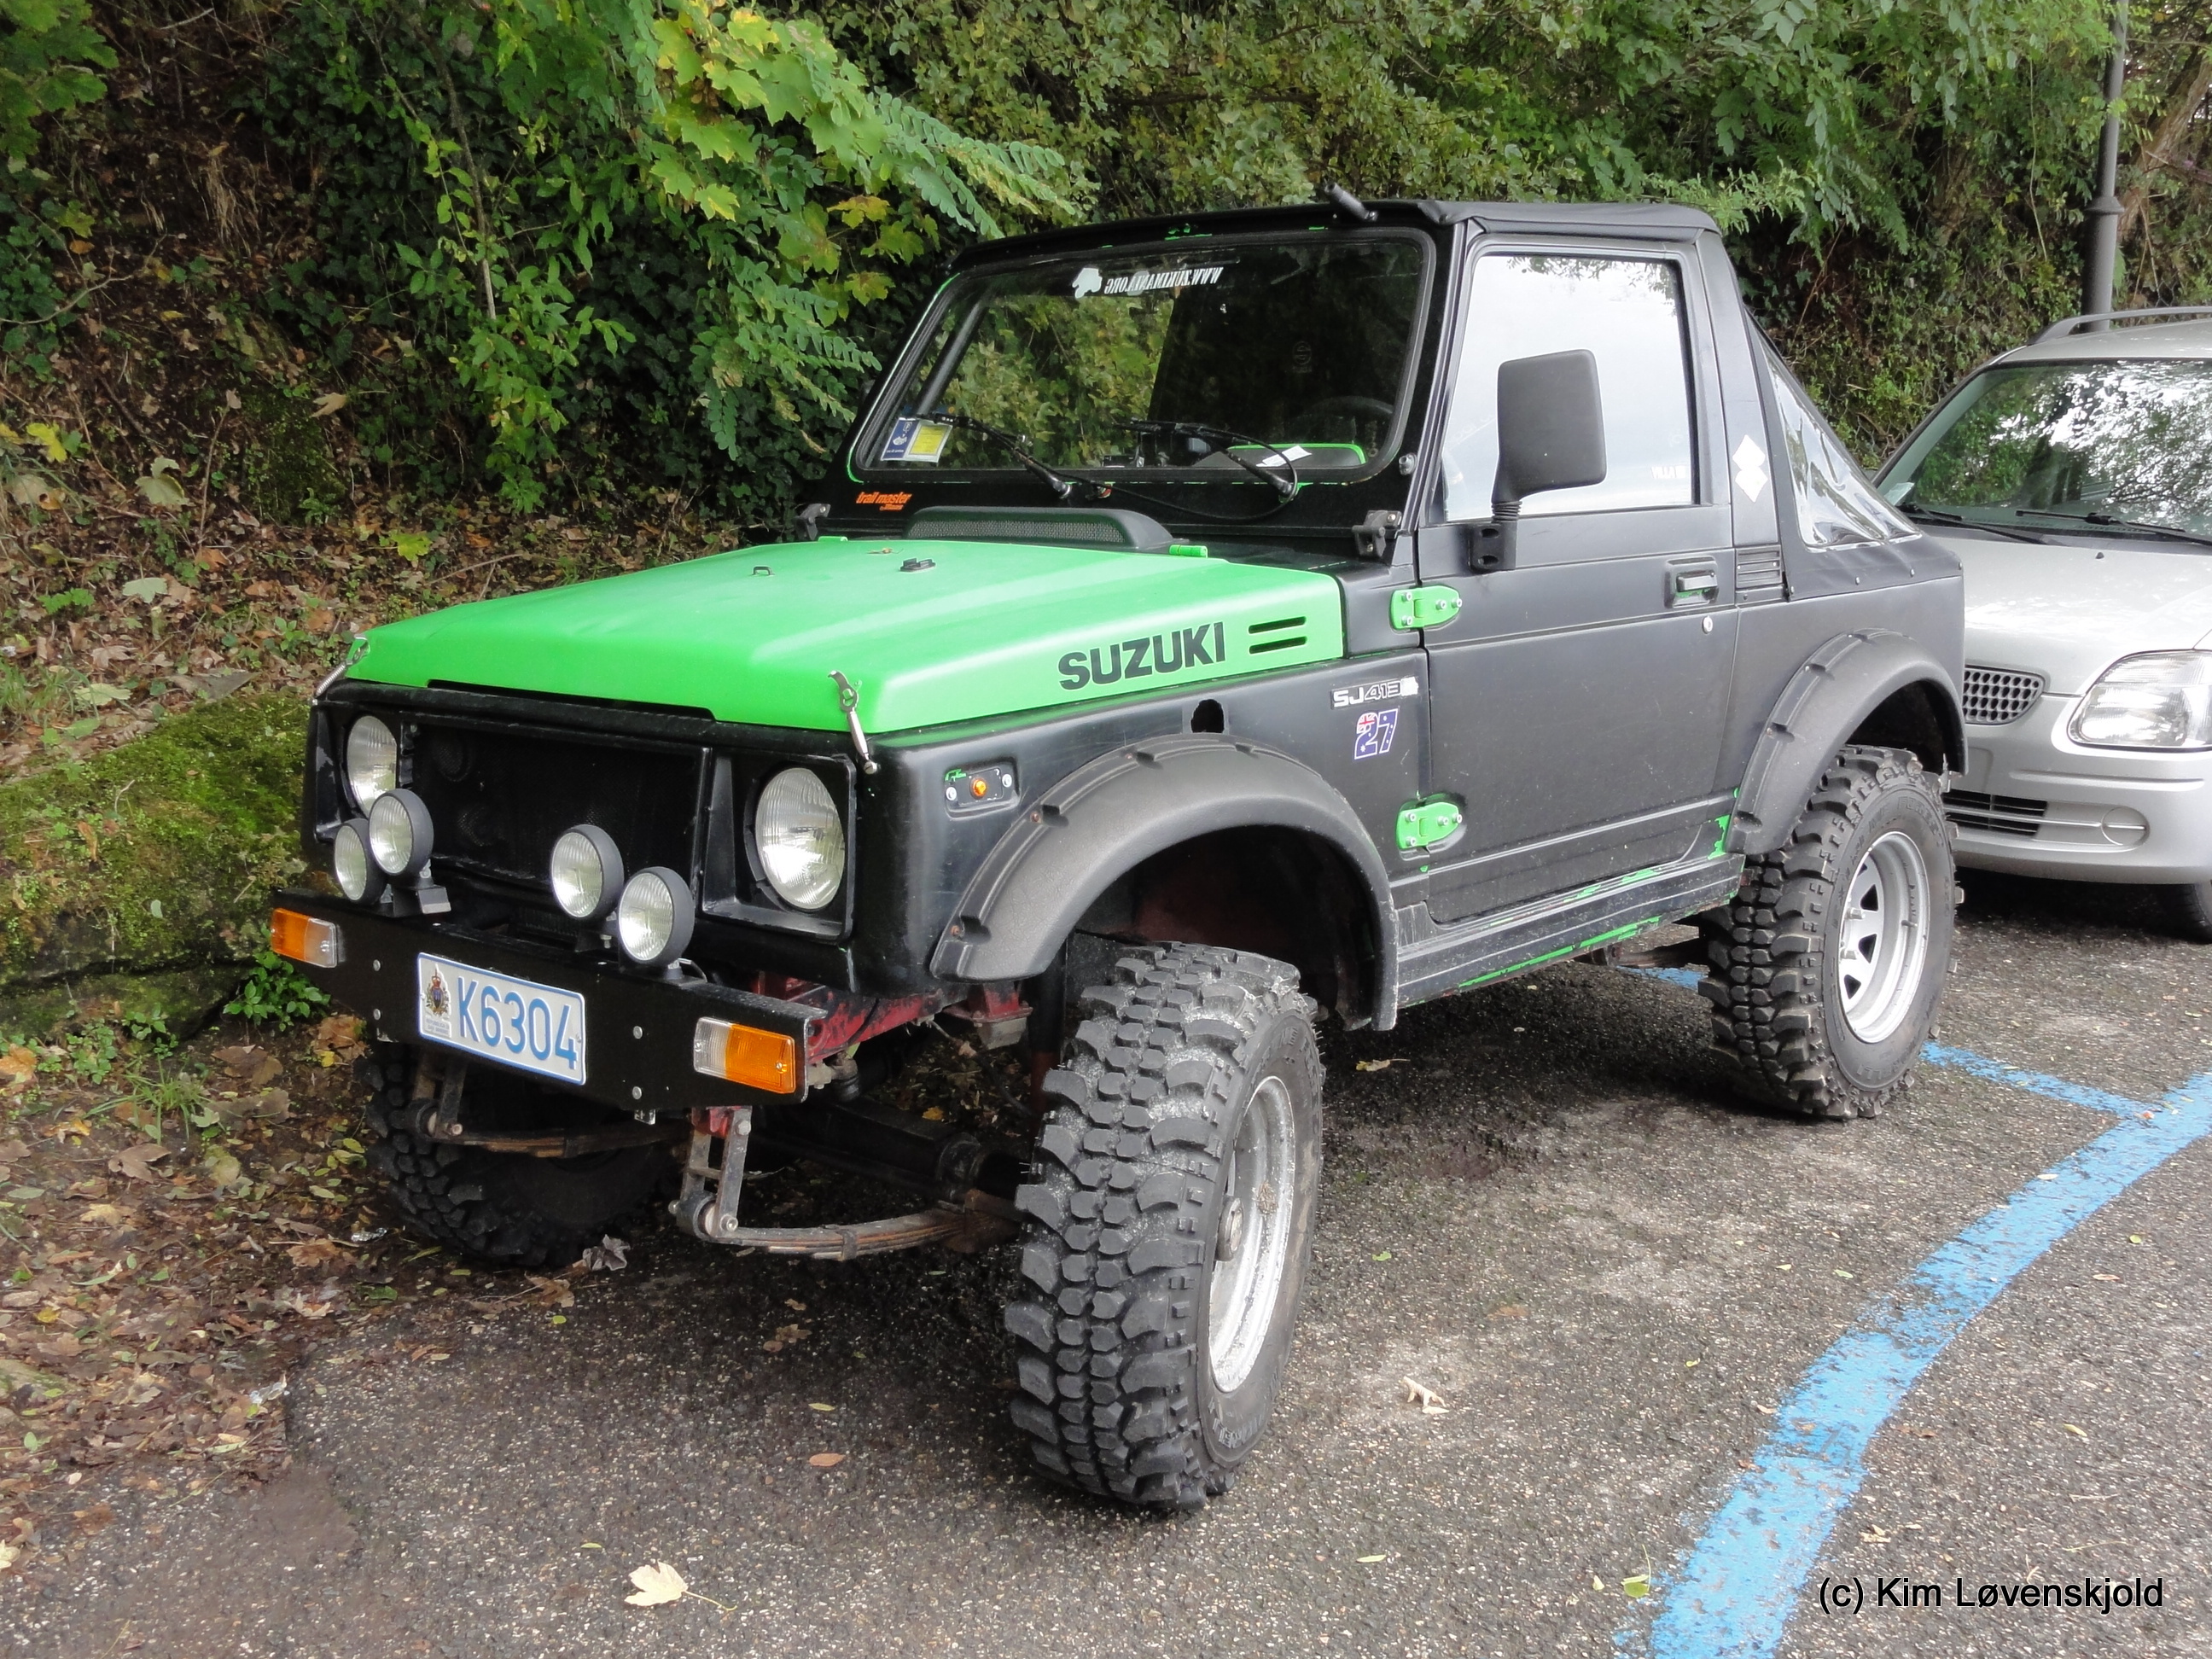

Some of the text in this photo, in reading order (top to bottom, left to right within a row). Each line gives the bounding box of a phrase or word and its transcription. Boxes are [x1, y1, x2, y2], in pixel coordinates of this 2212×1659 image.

[856, 492, 912, 504] trail master
[1057, 621, 1226, 690] SUZUKI
[1333, 680, 1401, 707] SJ413
[1353, 708, 1399, 760] 27
[457, 975, 578, 1070] K6304
